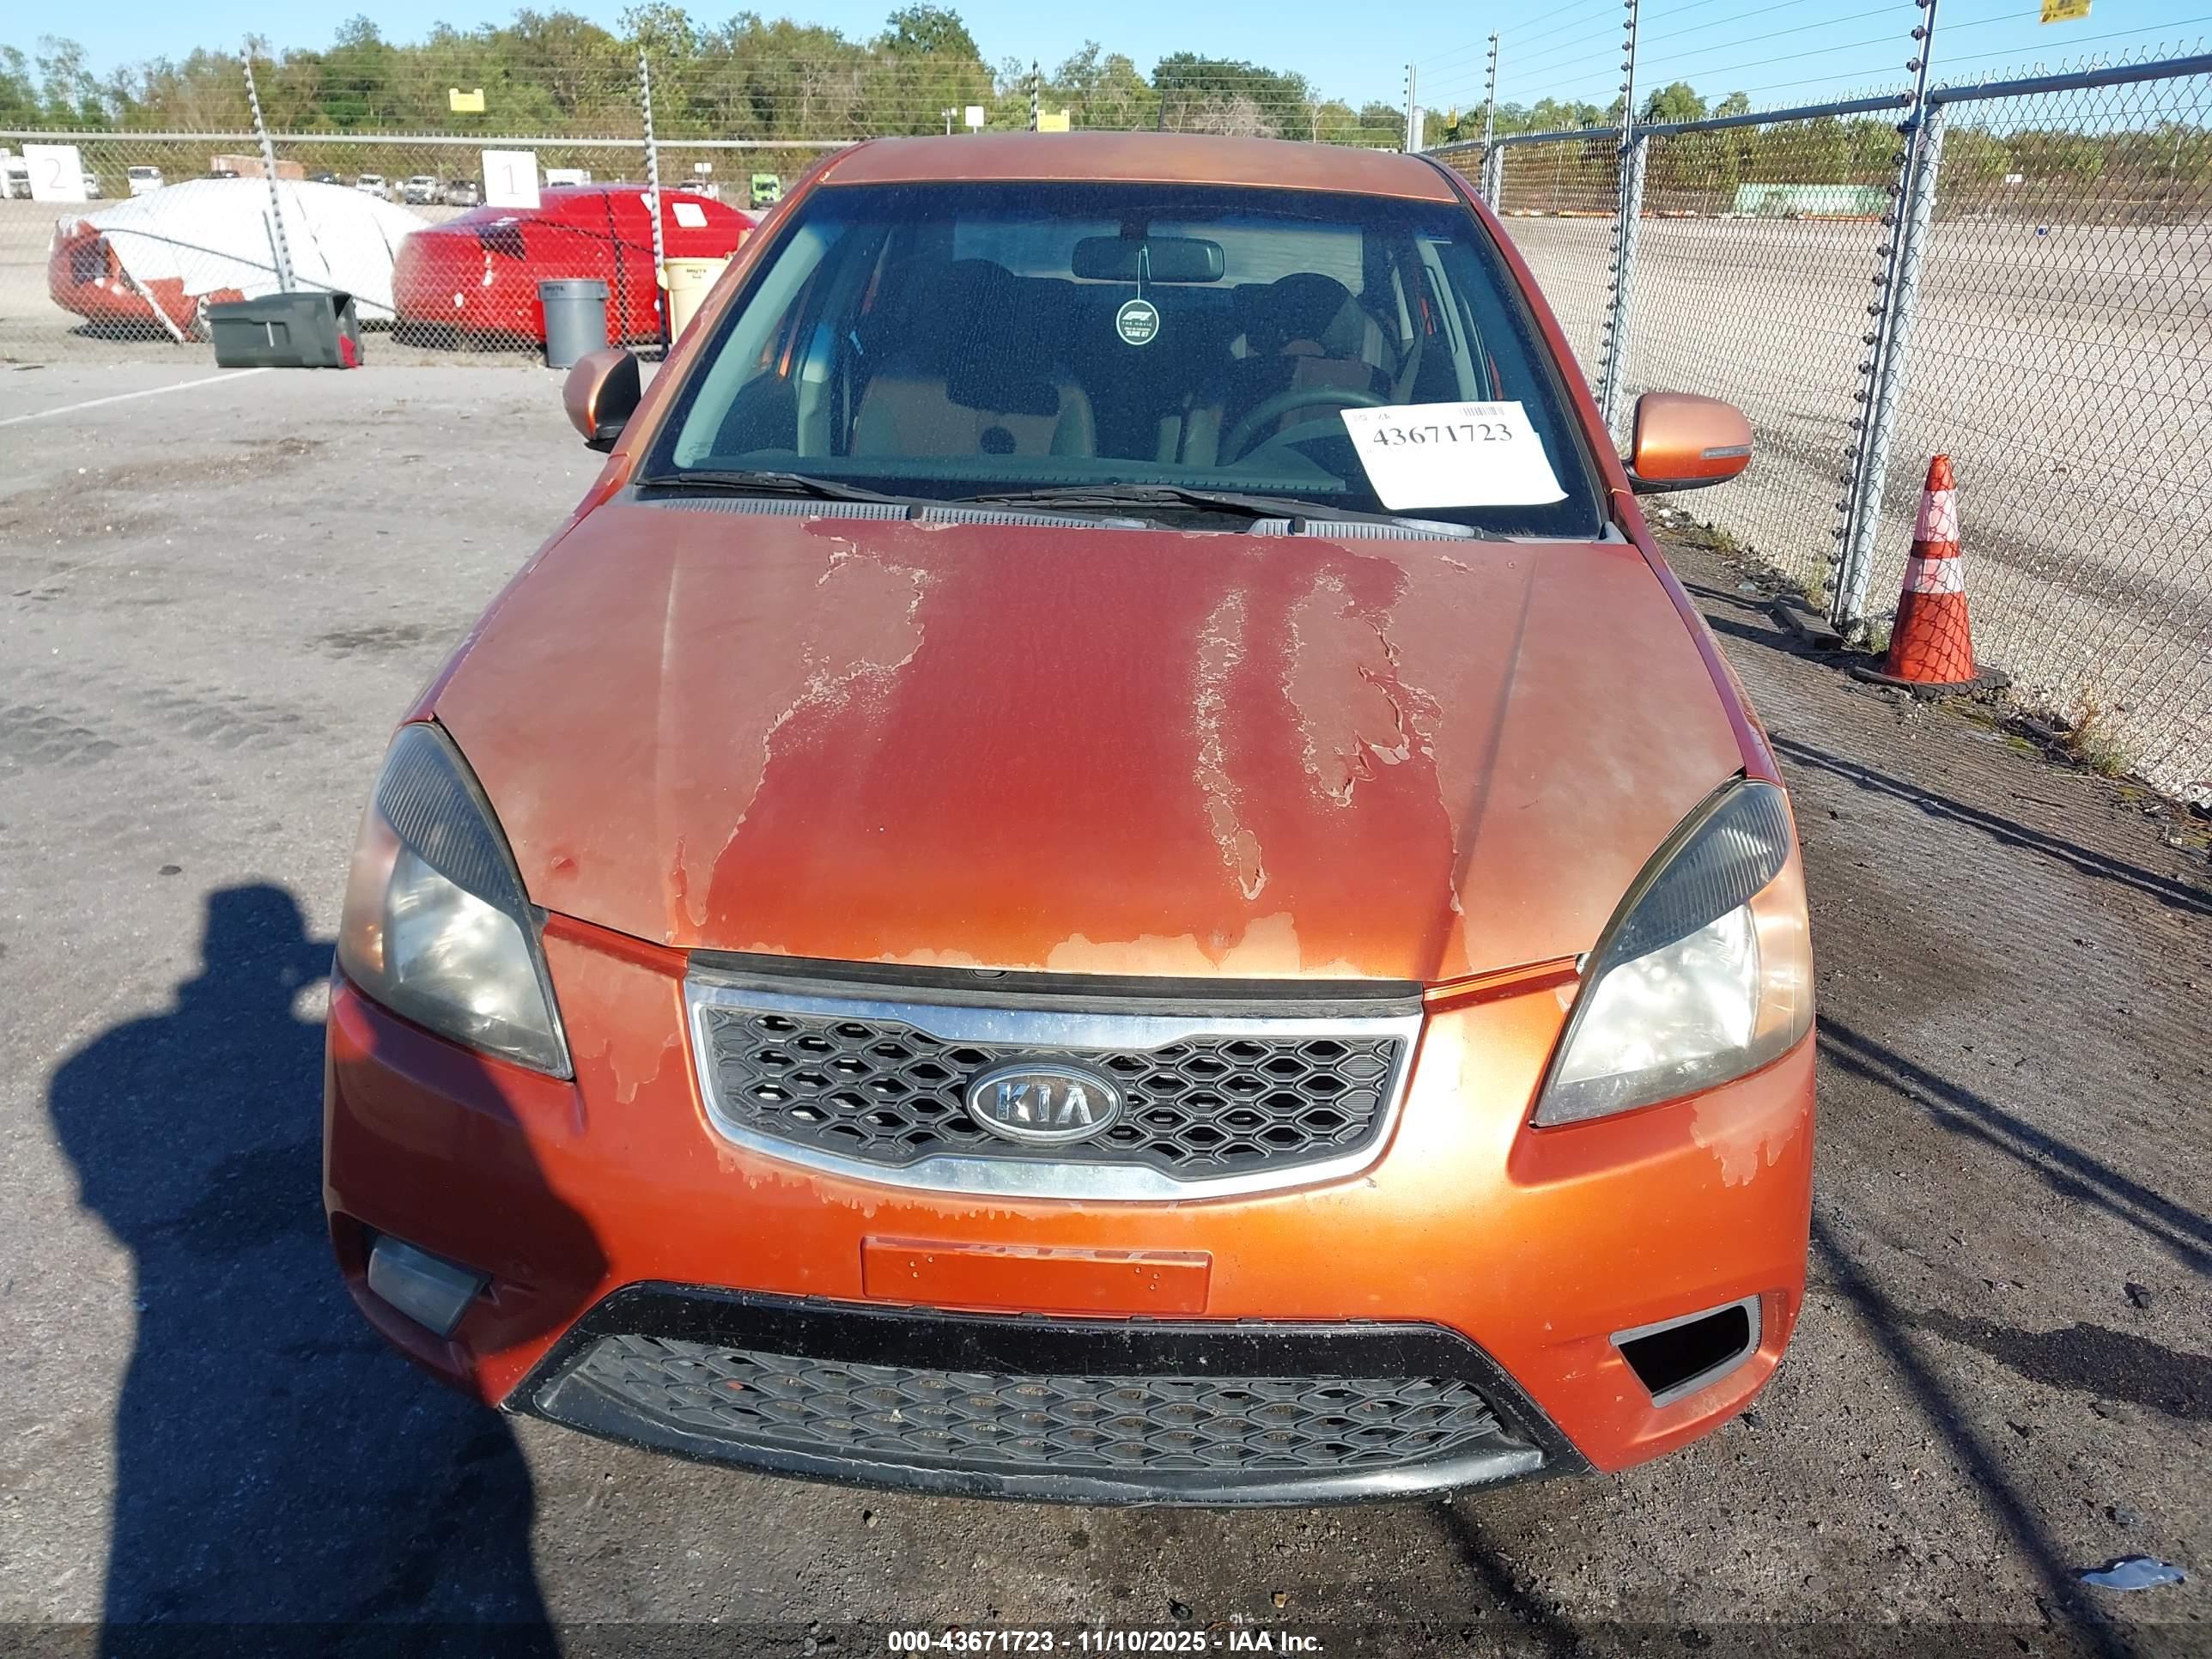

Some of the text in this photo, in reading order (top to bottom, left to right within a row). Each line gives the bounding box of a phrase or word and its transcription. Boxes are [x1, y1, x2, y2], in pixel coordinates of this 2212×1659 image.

[44, 157, 67, 189] 2
[502, 164, 522, 194] 1
[1373, 423, 1513, 446] 43671723
[996, 1082, 1093, 1124] KIA
